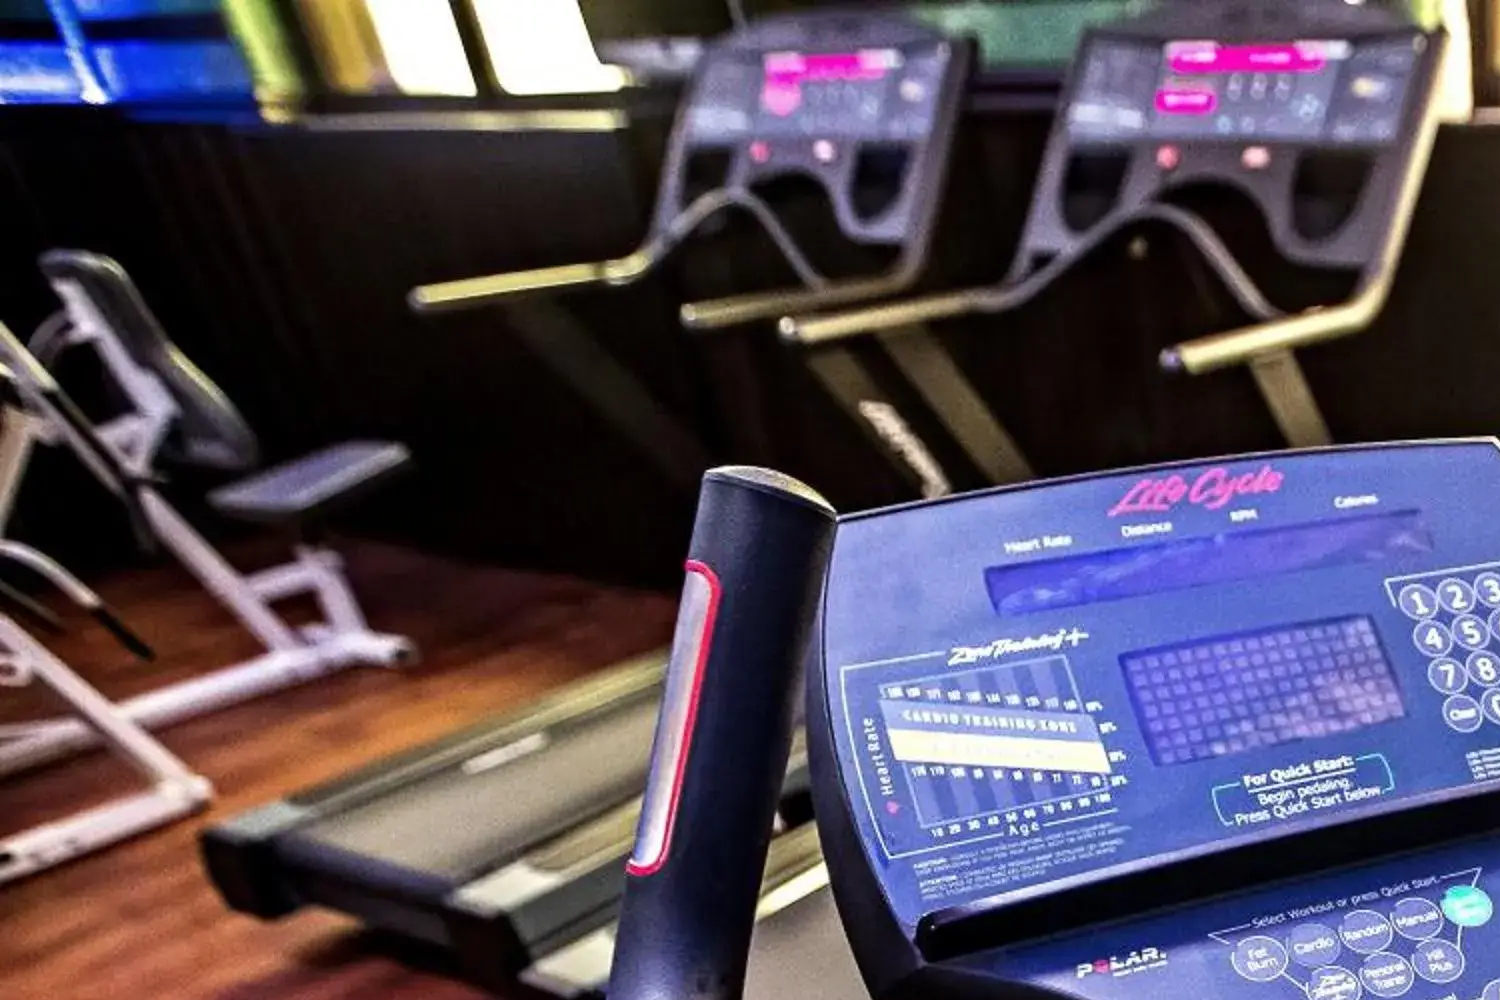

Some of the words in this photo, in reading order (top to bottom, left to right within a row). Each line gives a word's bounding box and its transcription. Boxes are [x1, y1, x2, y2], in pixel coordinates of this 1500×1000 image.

[1108, 475, 1187, 516] Life
[1189, 465, 1284, 509] Cycle
[1230, 508, 1258, 523] RPM
[1121, 520, 1173, 538] Distance
[1004, 540, 1041, 555] Heart
[1044, 534, 1072, 549] Rate
[1411, 591, 1430, 615] 1
[1447, 586, 1467, 609] 2
[1424, 627, 1443, 649] 4
[1461, 621, 1481, 644] 5
[1438, 664, 1454, 688] 7
[1476, 658, 1496, 681] 8
[903, 709, 959, 726] CARDIO
[962, 713, 1036, 732] TRAINING
[863, 718, 880, 752] Rate
[872, 753, 896, 797] Heart
[1243, 773, 1267, 788] For
[1271, 763, 1312, 782] Quick
[1313, 754, 1355, 772] Start:
[1257, 788, 1295, 806] Begin
[1234, 809, 1271, 827] Press
[1273, 801, 1309, 818] Quick
[1311, 795, 1341, 810] Start
[1008, 821, 1040, 837] Age
[1252, 914, 1286, 928] Select
[1289, 902, 1334, 919] Workout
[1336, 899, 1347, 909] or
[1351, 891, 1379, 907] press
[1381, 881, 1409, 898] Quick
[1396, 910, 1439, 928] Manual
[1343, 923, 1389, 941] Random
[1247, 946, 1268, 958] Fat
[1293, 937, 1335, 954] Cardio
[1246, 956, 1279, 972] Burn
[1364, 963, 1406, 979] Personal
[1429, 962, 1454, 975] Plus
